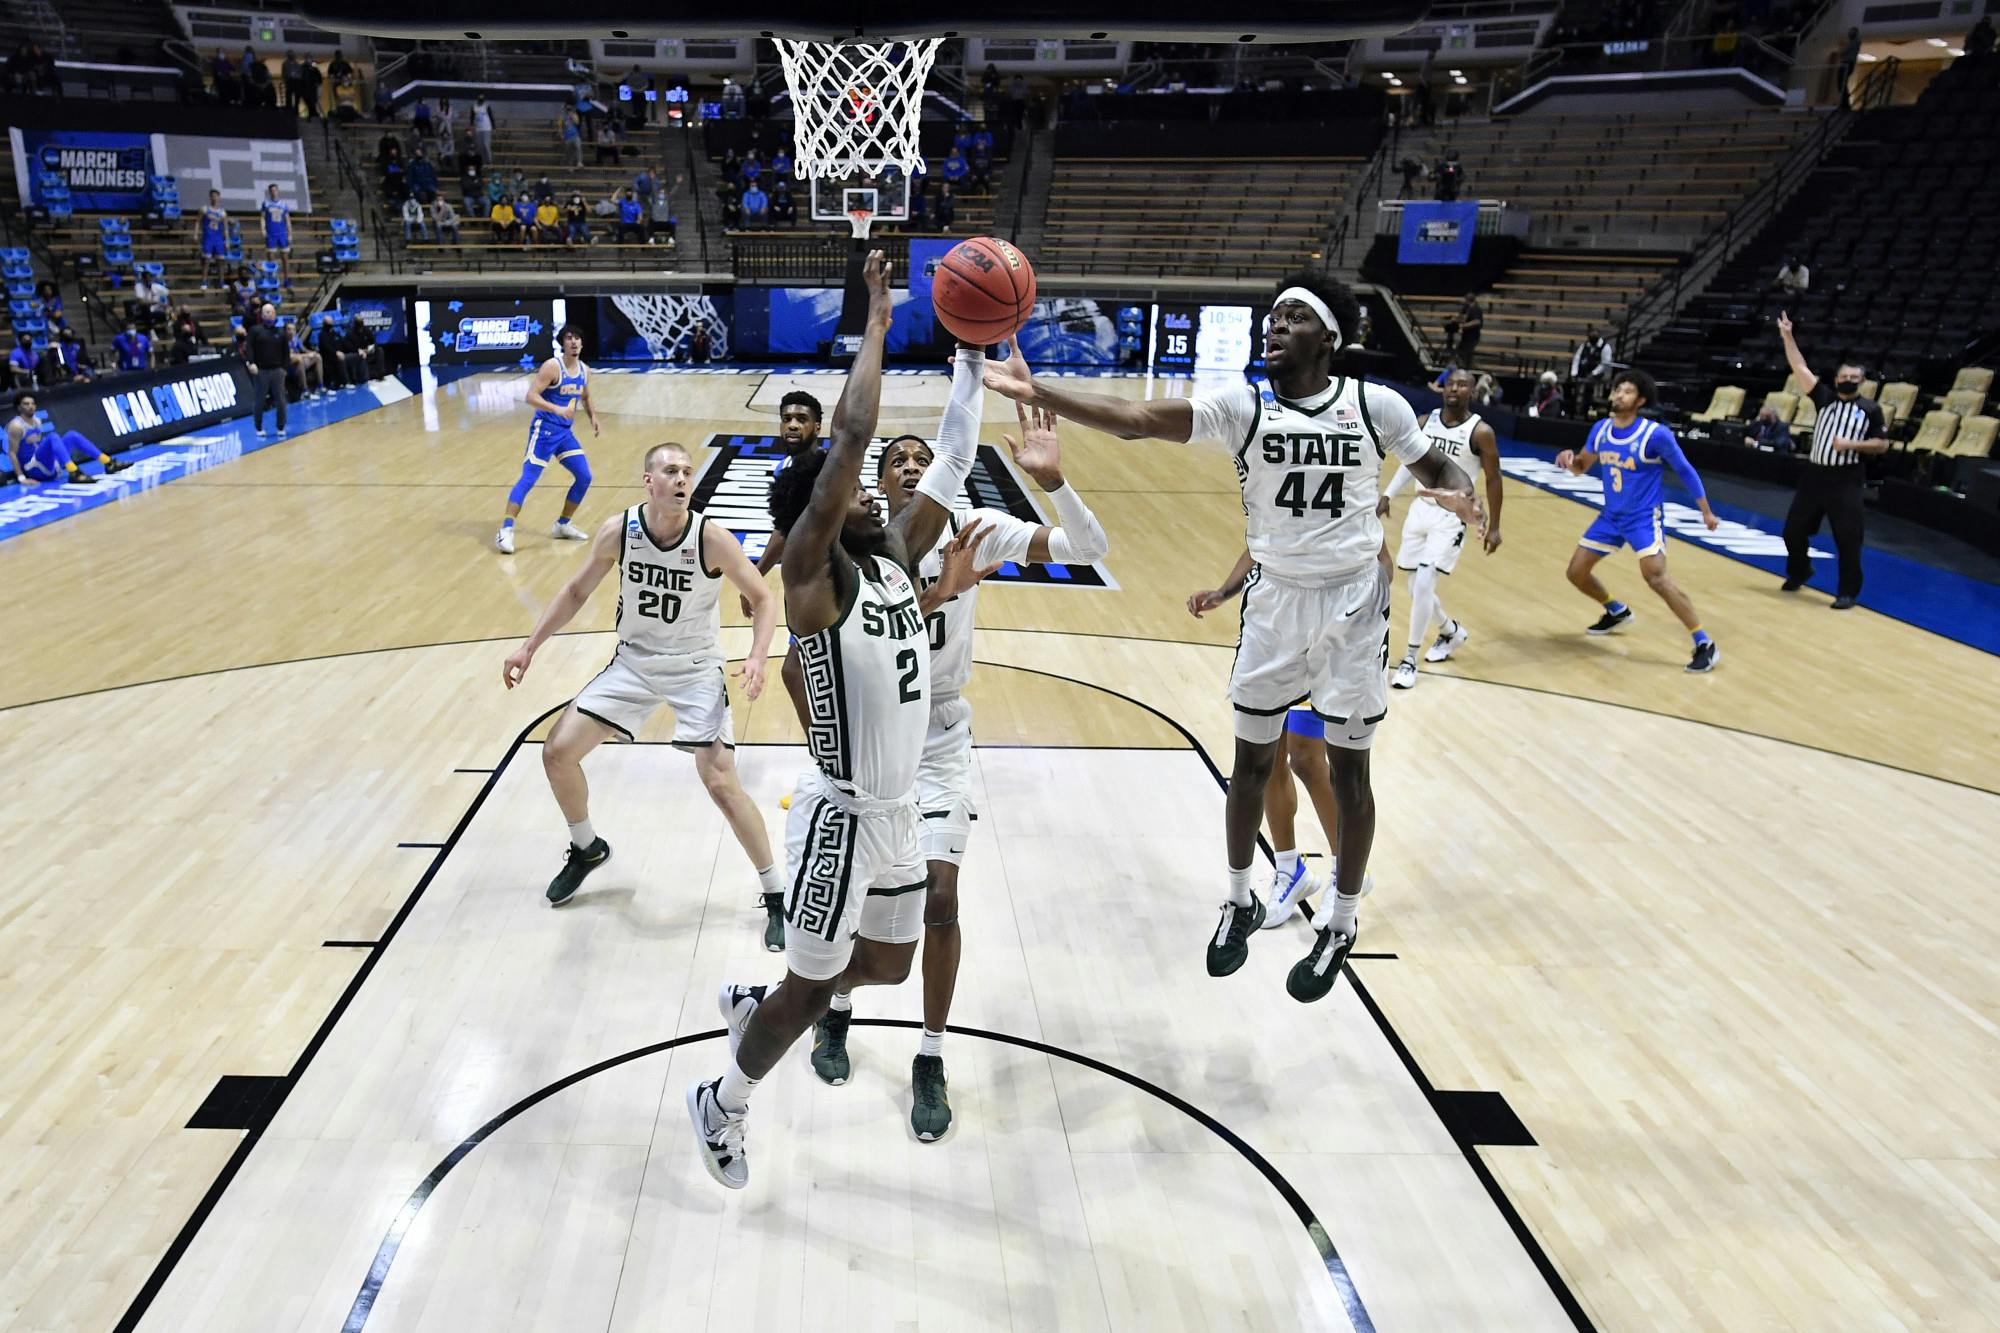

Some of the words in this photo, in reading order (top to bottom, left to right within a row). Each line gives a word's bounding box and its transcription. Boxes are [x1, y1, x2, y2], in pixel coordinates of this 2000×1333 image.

[60, 150, 117, 168] MARCH
[70, 169, 145, 188] MADNESS
[472, 320, 509, 333] MARCH
[477, 331, 527, 345] MADNESS
[1166, 335, 1188, 354] 15
[102, 372, 237, 436] NCAA.COM/SHOP
[1262, 432, 1364, 466] STATE
[1600, 450, 1636, 471] UCLA
[1610, 466, 1623, 493] 3
[1275, 471, 1346, 518] 44
[628, 561, 695, 592] STATE
[638, 590, 682, 624] 20
[896, 648, 921, 704] 2
